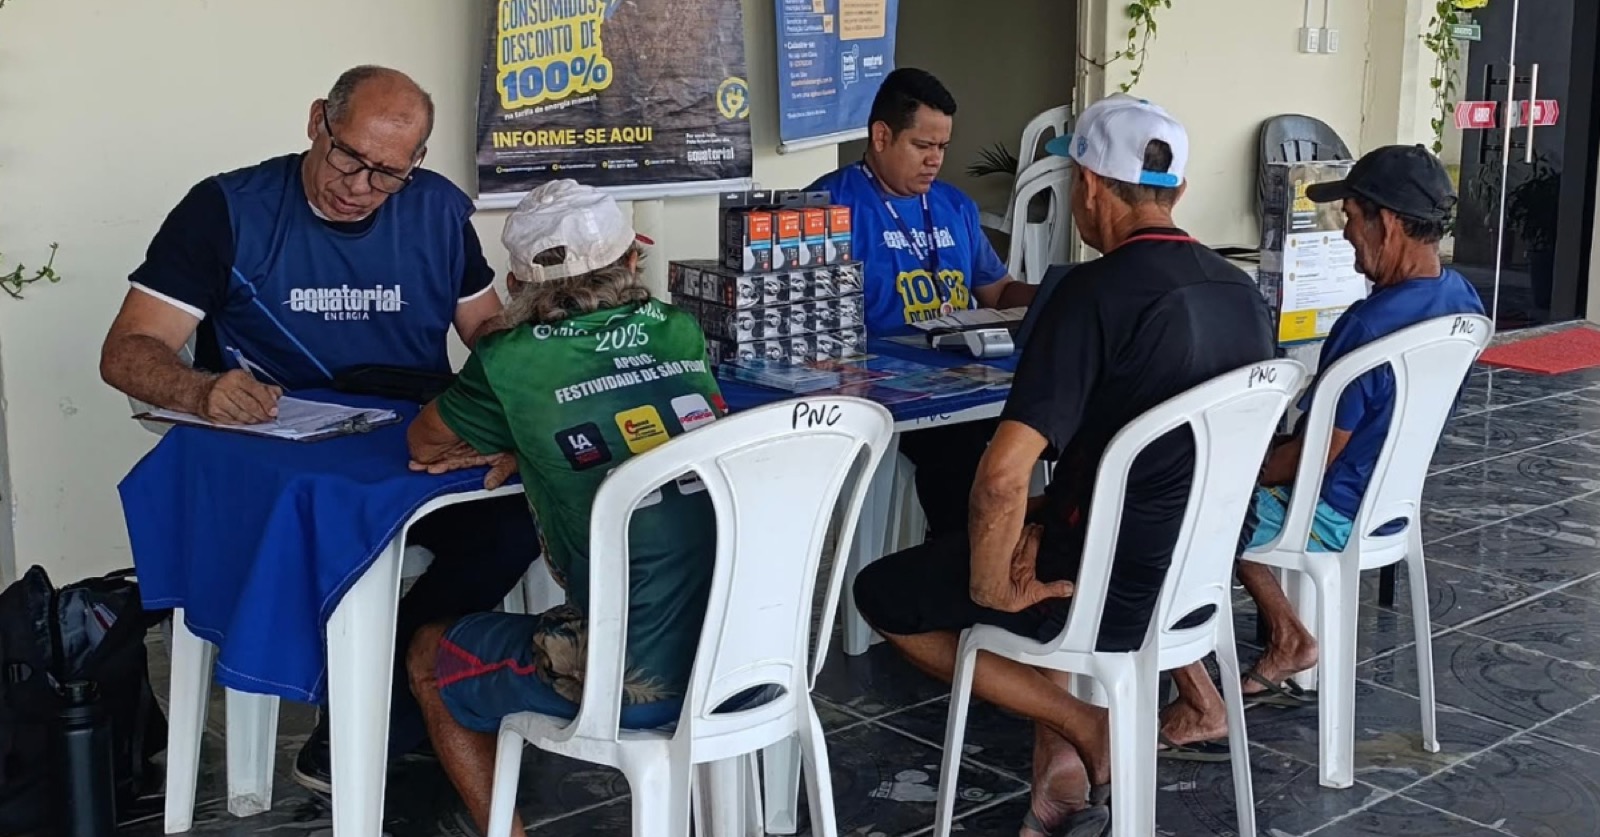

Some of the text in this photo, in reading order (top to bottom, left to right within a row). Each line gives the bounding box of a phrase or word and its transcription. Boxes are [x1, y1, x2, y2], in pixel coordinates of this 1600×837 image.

[502, 19, 597, 65] DESCONTO DE
[502, 53, 607, 102] 100%
[493, 127, 653, 149] INFORME-SE AQUI
[687, 147, 734, 162] equatorial
[883, 226, 956, 249] equtoial
[290, 284, 401, 313] equatorial
[900, 274, 967, 306] 10%
[324, 311, 370, 321] ENERGIA
[1450, 316, 1476, 336] PNC
[595, 322, 649, 352] 2025
[613, 353, 657, 369] APOIO:
[555, 371, 643, 404] FESTIVIDADE
[639, 367, 660, 382] DE
[656, 360, 684, 378] SÃO
[1247, 366, 1278, 389] PNC
[792, 402, 842, 429] PNC
